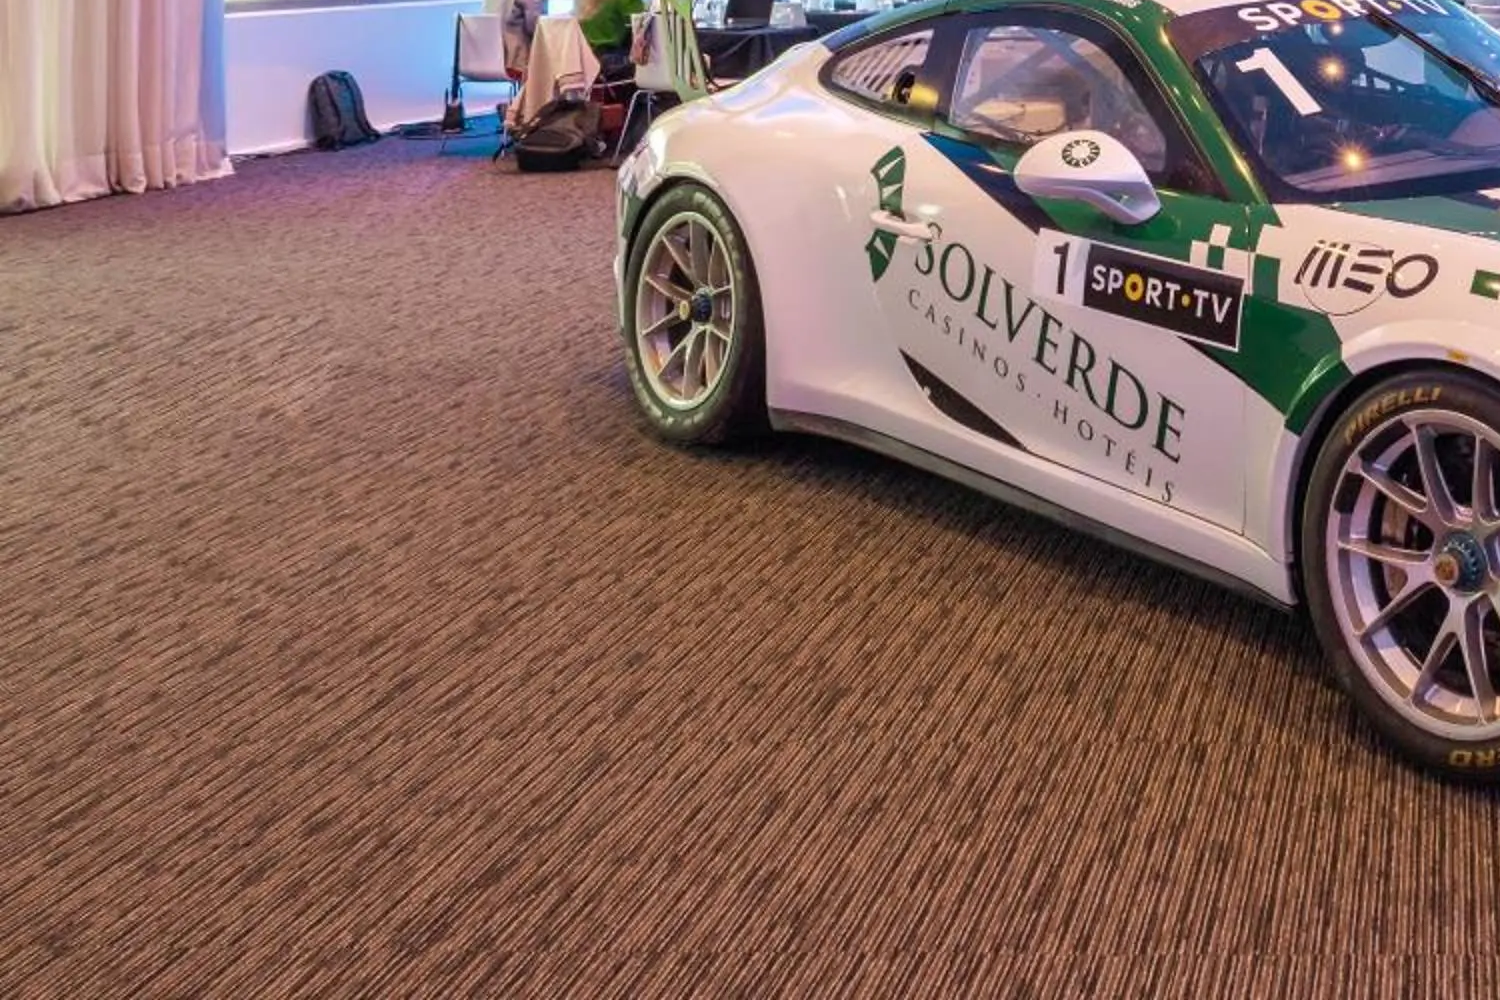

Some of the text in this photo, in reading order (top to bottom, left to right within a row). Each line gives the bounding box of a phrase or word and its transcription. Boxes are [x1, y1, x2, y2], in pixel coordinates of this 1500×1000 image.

[1236, 47, 1323, 116] 1
[1053, 242, 1070, 295] 1
[908, 289, 1026, 392] CASINOS
[914, 222, 1186, 463] SOLVERDE
[1344, 386, 1442, 447] PIRELLI
